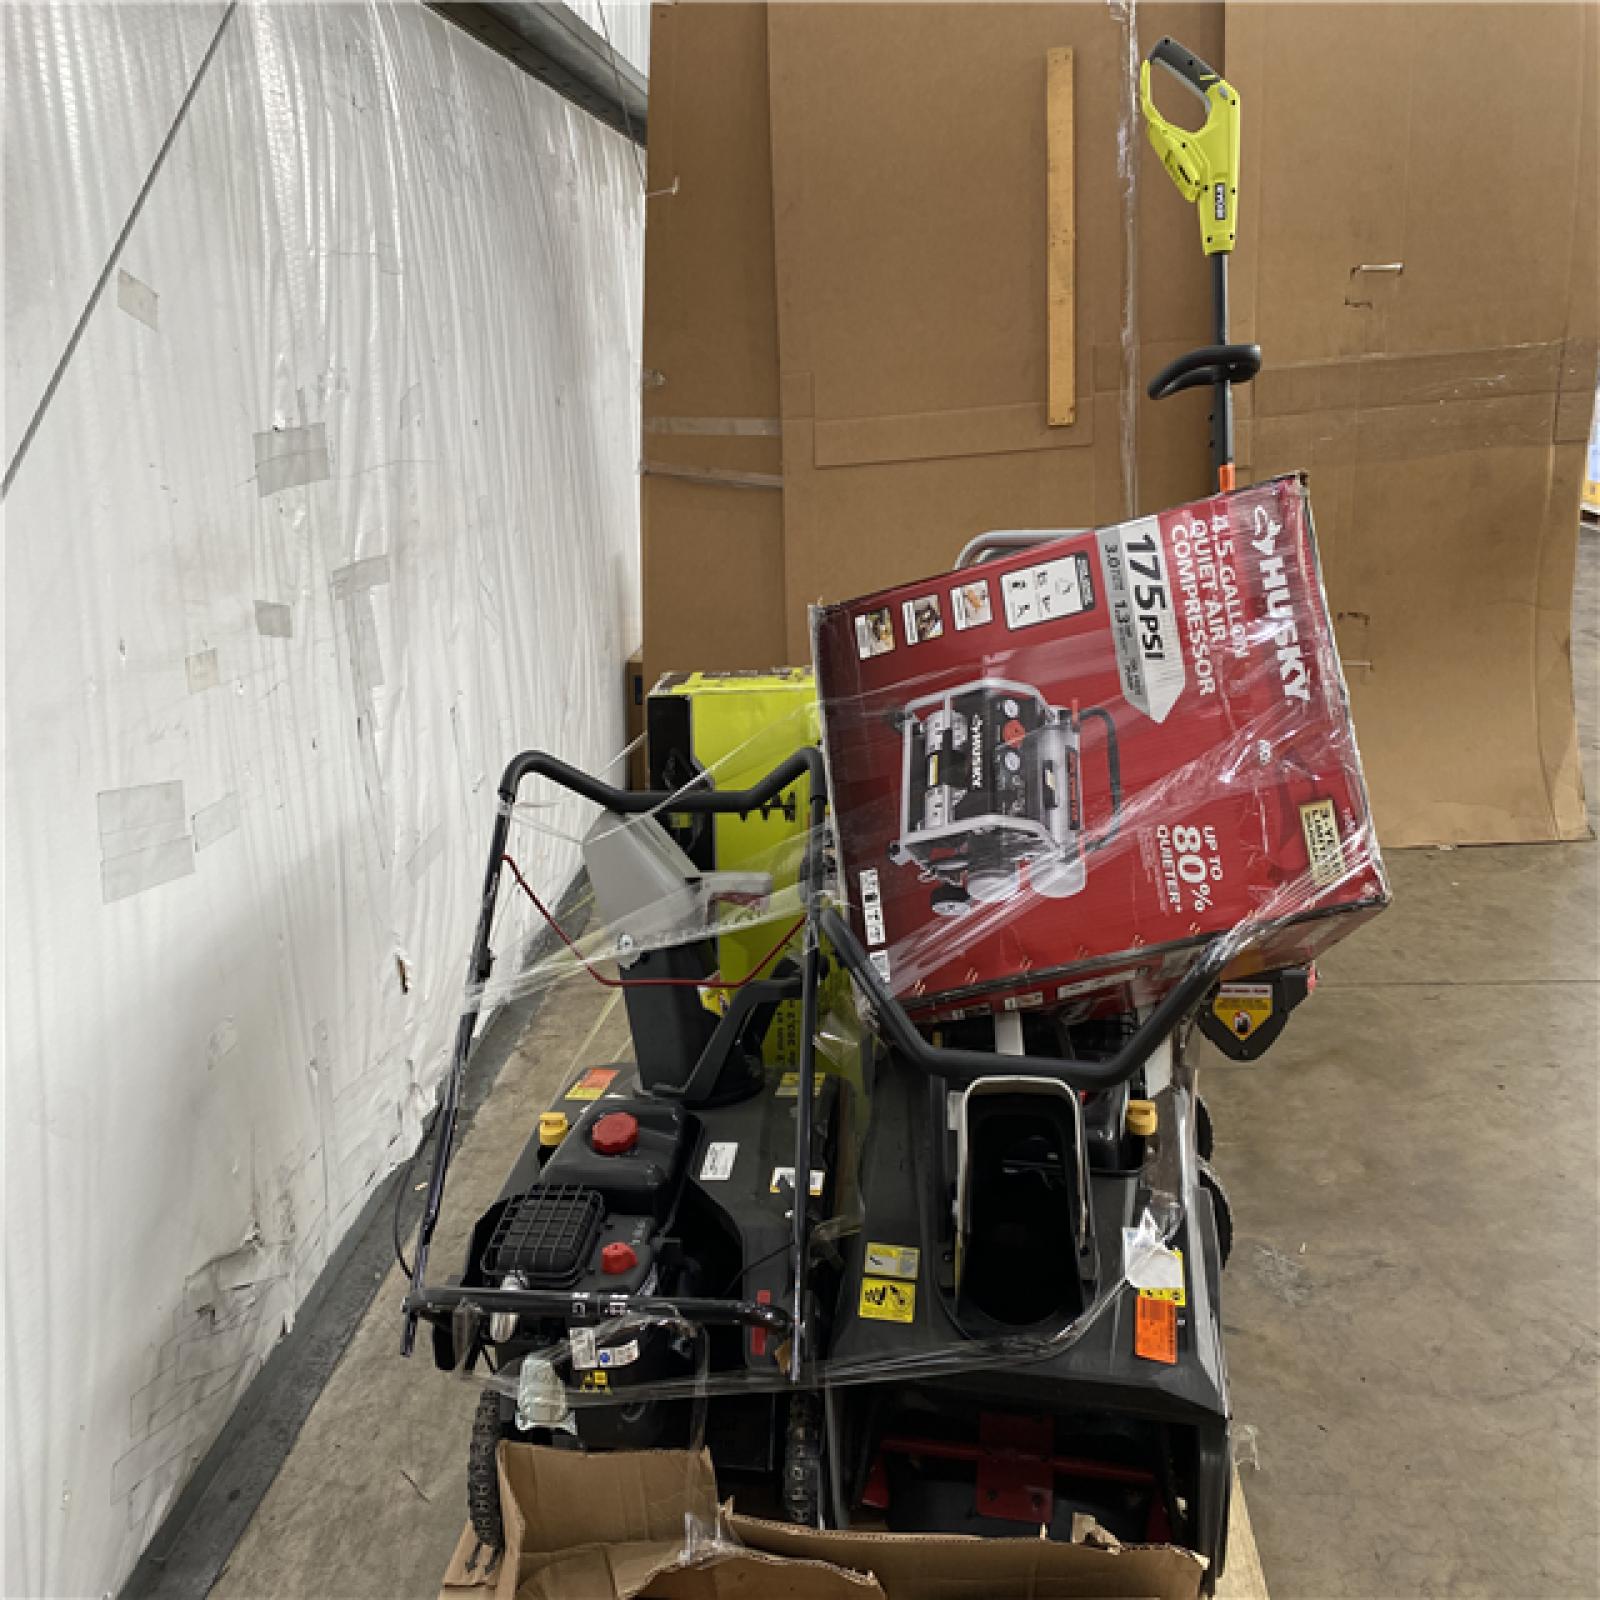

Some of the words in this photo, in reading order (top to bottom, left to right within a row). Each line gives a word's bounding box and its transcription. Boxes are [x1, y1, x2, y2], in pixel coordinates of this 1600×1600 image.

[1126, 533, 1166, 610] 175
[1212, 515, 1233, 556] 4.5
[1172, 524, 1216, 696] COMPRESSOR
[1190, 519, 1218, 590] QUIET
[1204, 593, 1226, 643] AIR
[1220, 566, 1250, 657] GALLON
[1138, 614, 1165, 660] PSI
[1260, 556, 1310, 700] HUSKY
[1173, 824, 1213, 913] 80%
[1203, 825, 1218, 851] UP
[1208, 855, 1223, 881] TO
